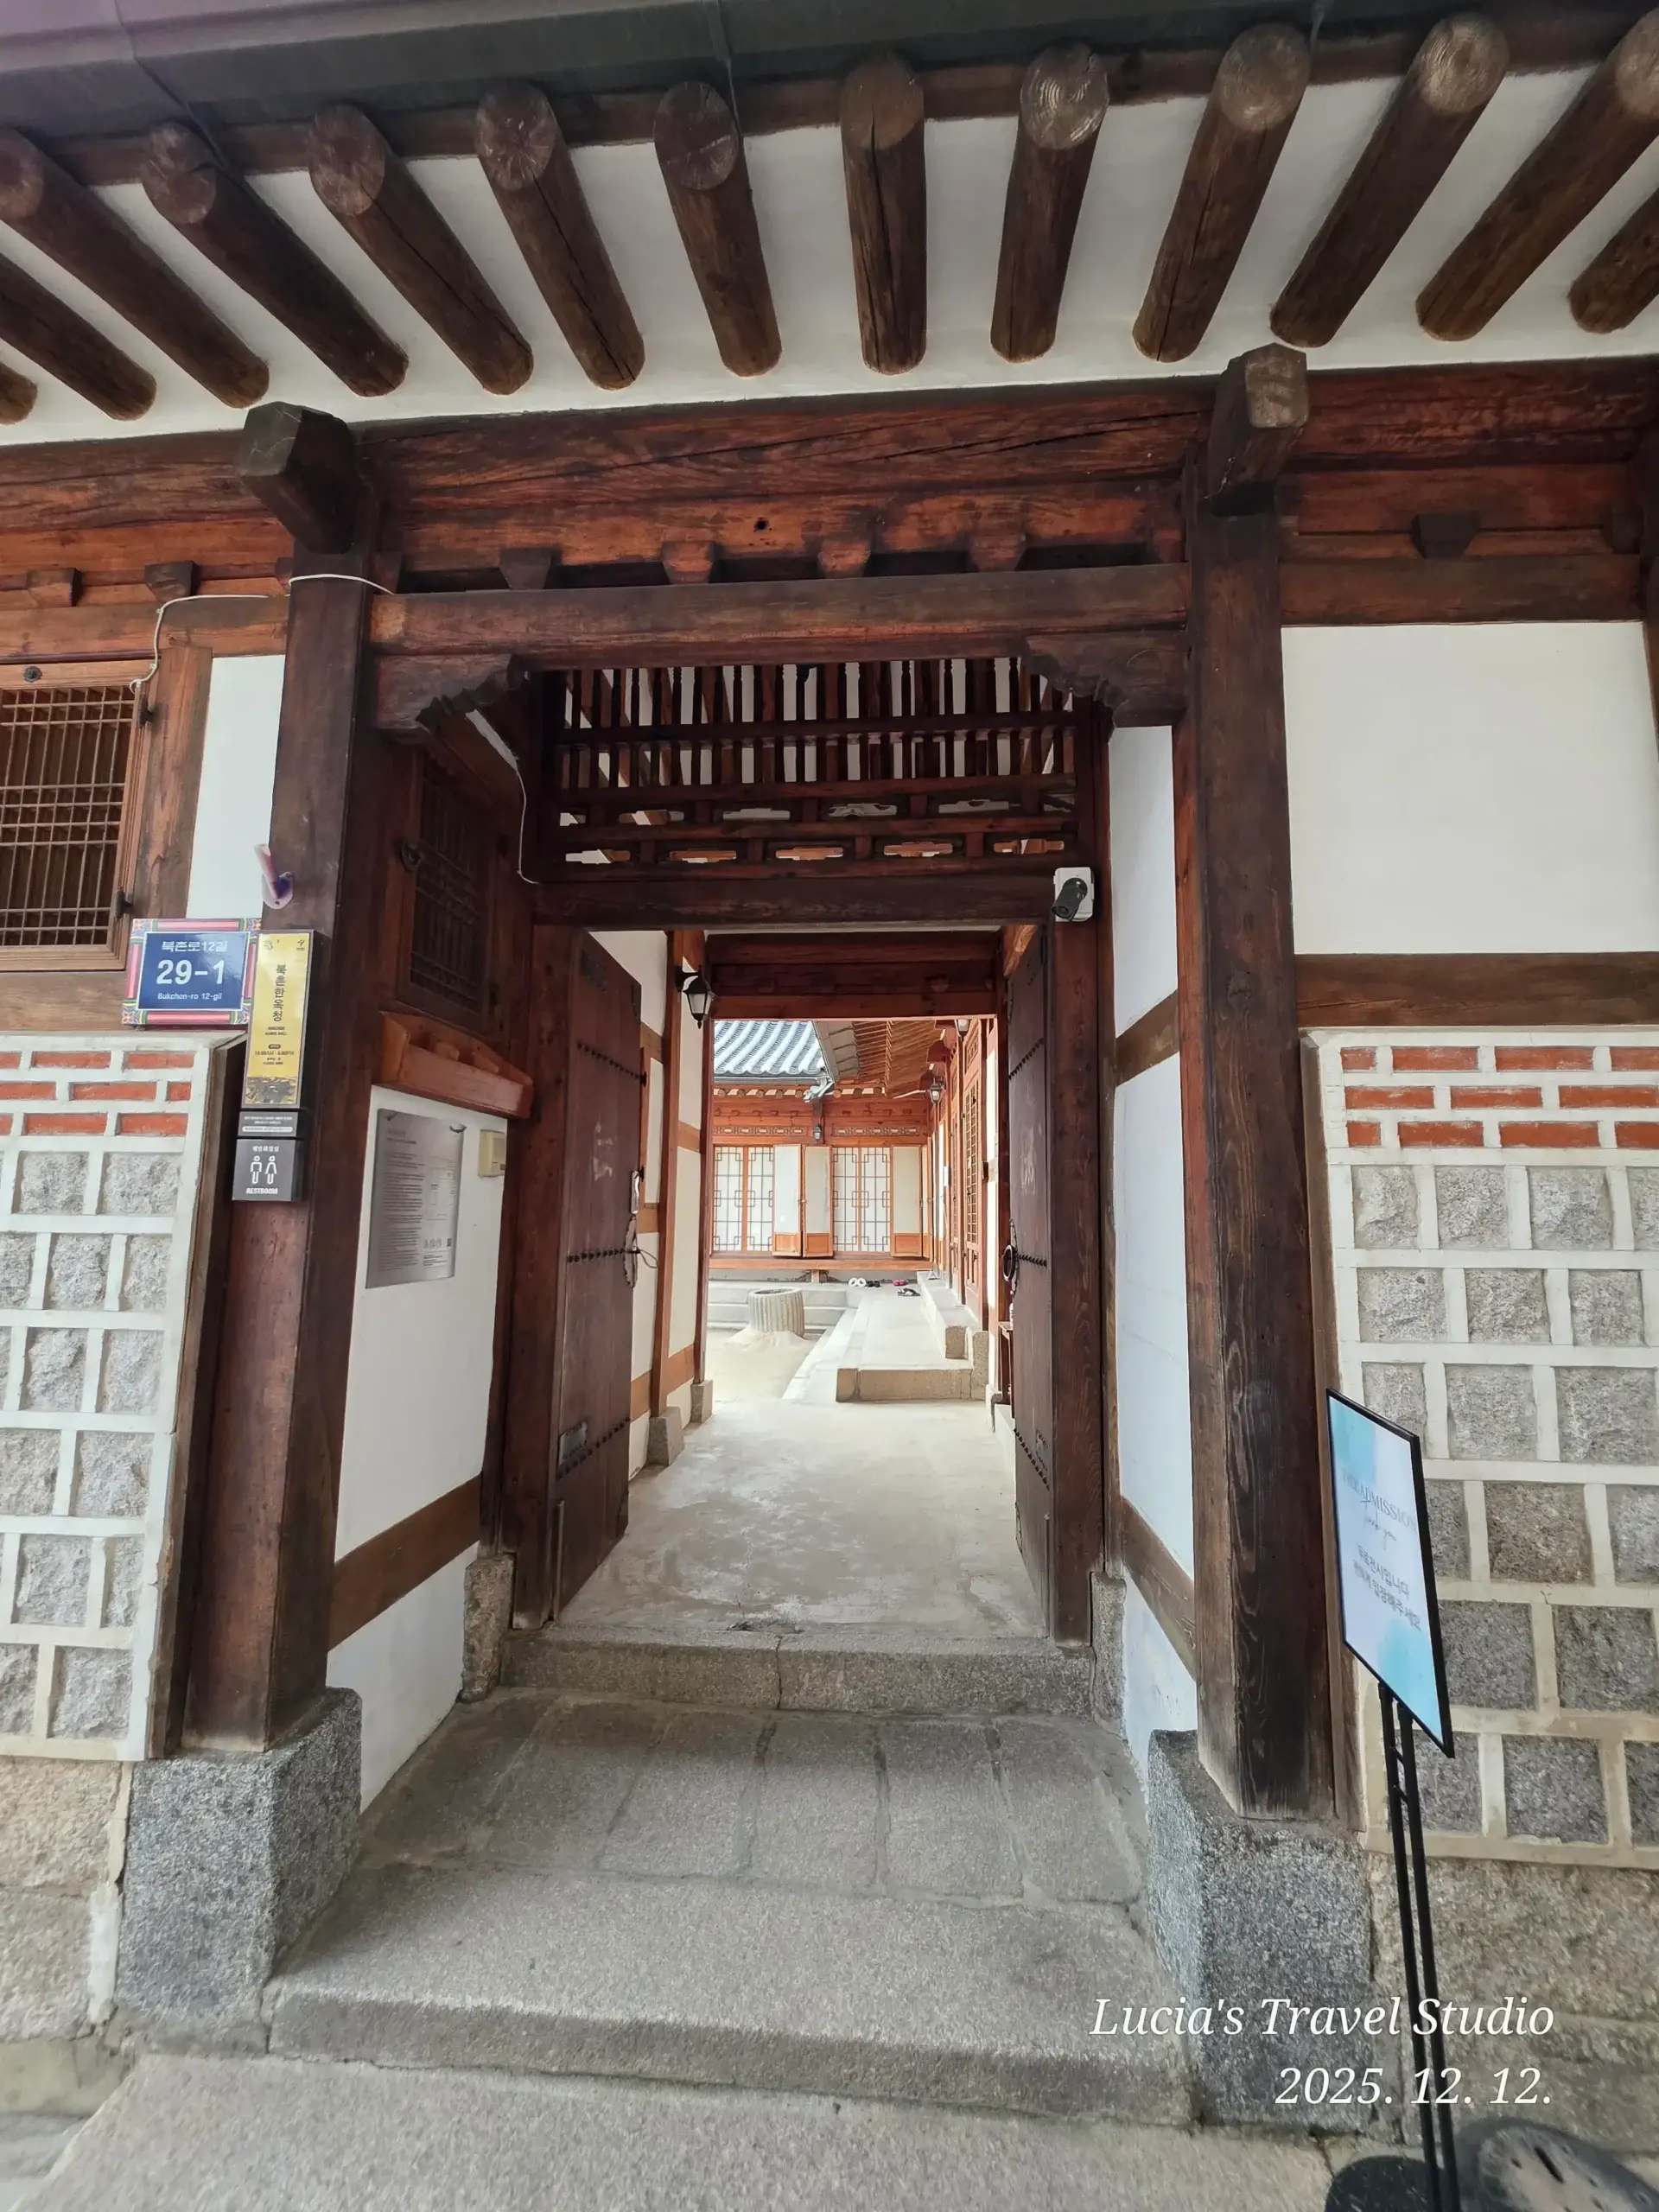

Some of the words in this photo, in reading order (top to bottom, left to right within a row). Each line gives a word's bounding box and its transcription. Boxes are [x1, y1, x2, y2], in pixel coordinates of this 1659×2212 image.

[162, 940, 228, 952] 북촌로12길
[156, 959, 225, 984] 29-1
[201, 992, 223, 1001] 12-gil
